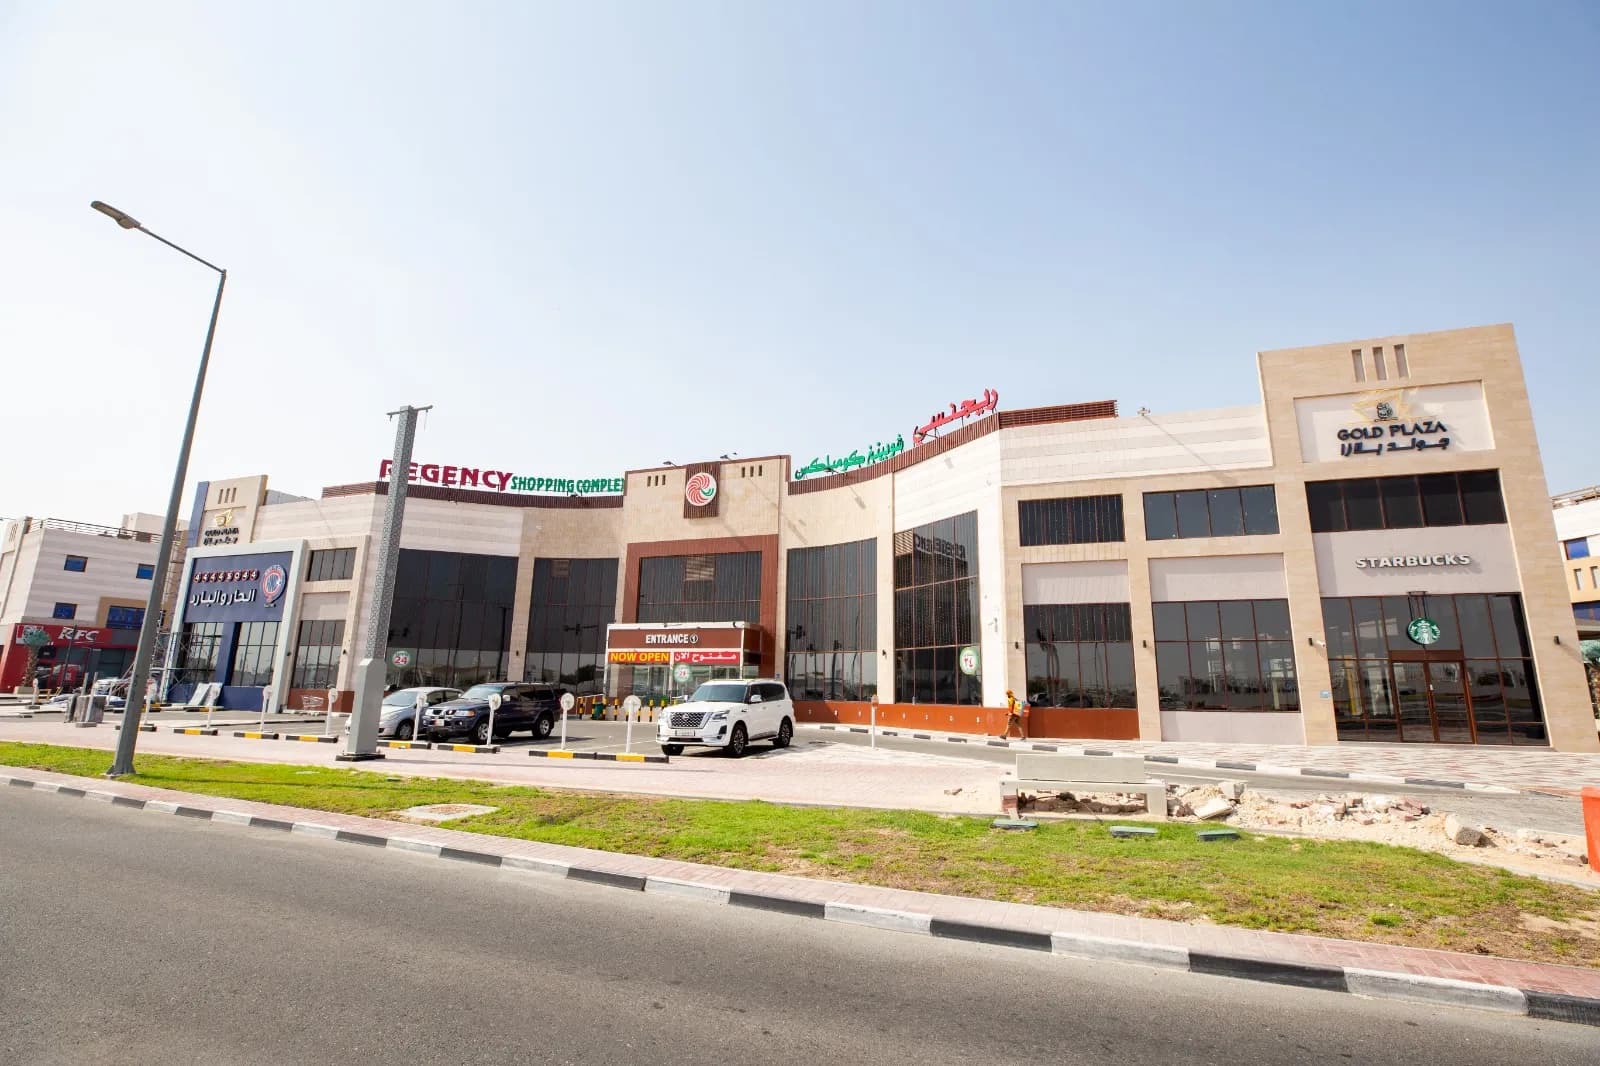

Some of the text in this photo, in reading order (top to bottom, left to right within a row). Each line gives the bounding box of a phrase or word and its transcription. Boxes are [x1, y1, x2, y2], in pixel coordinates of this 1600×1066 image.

[1337, 420, 1447, 441] GOLD PLAZA
[511, 475, 575, 493] SHOPPING
[1355, 553, 1471, 569] STARBUCKS
[58, 626, 99, 641] KFC
[645, 634, 689, 644] ENTRANCE
[394, 656, 408, 664] 24
[610, 652, 670, 662] NOW OPEN
[692, 652, 737, 663] مفتوح
